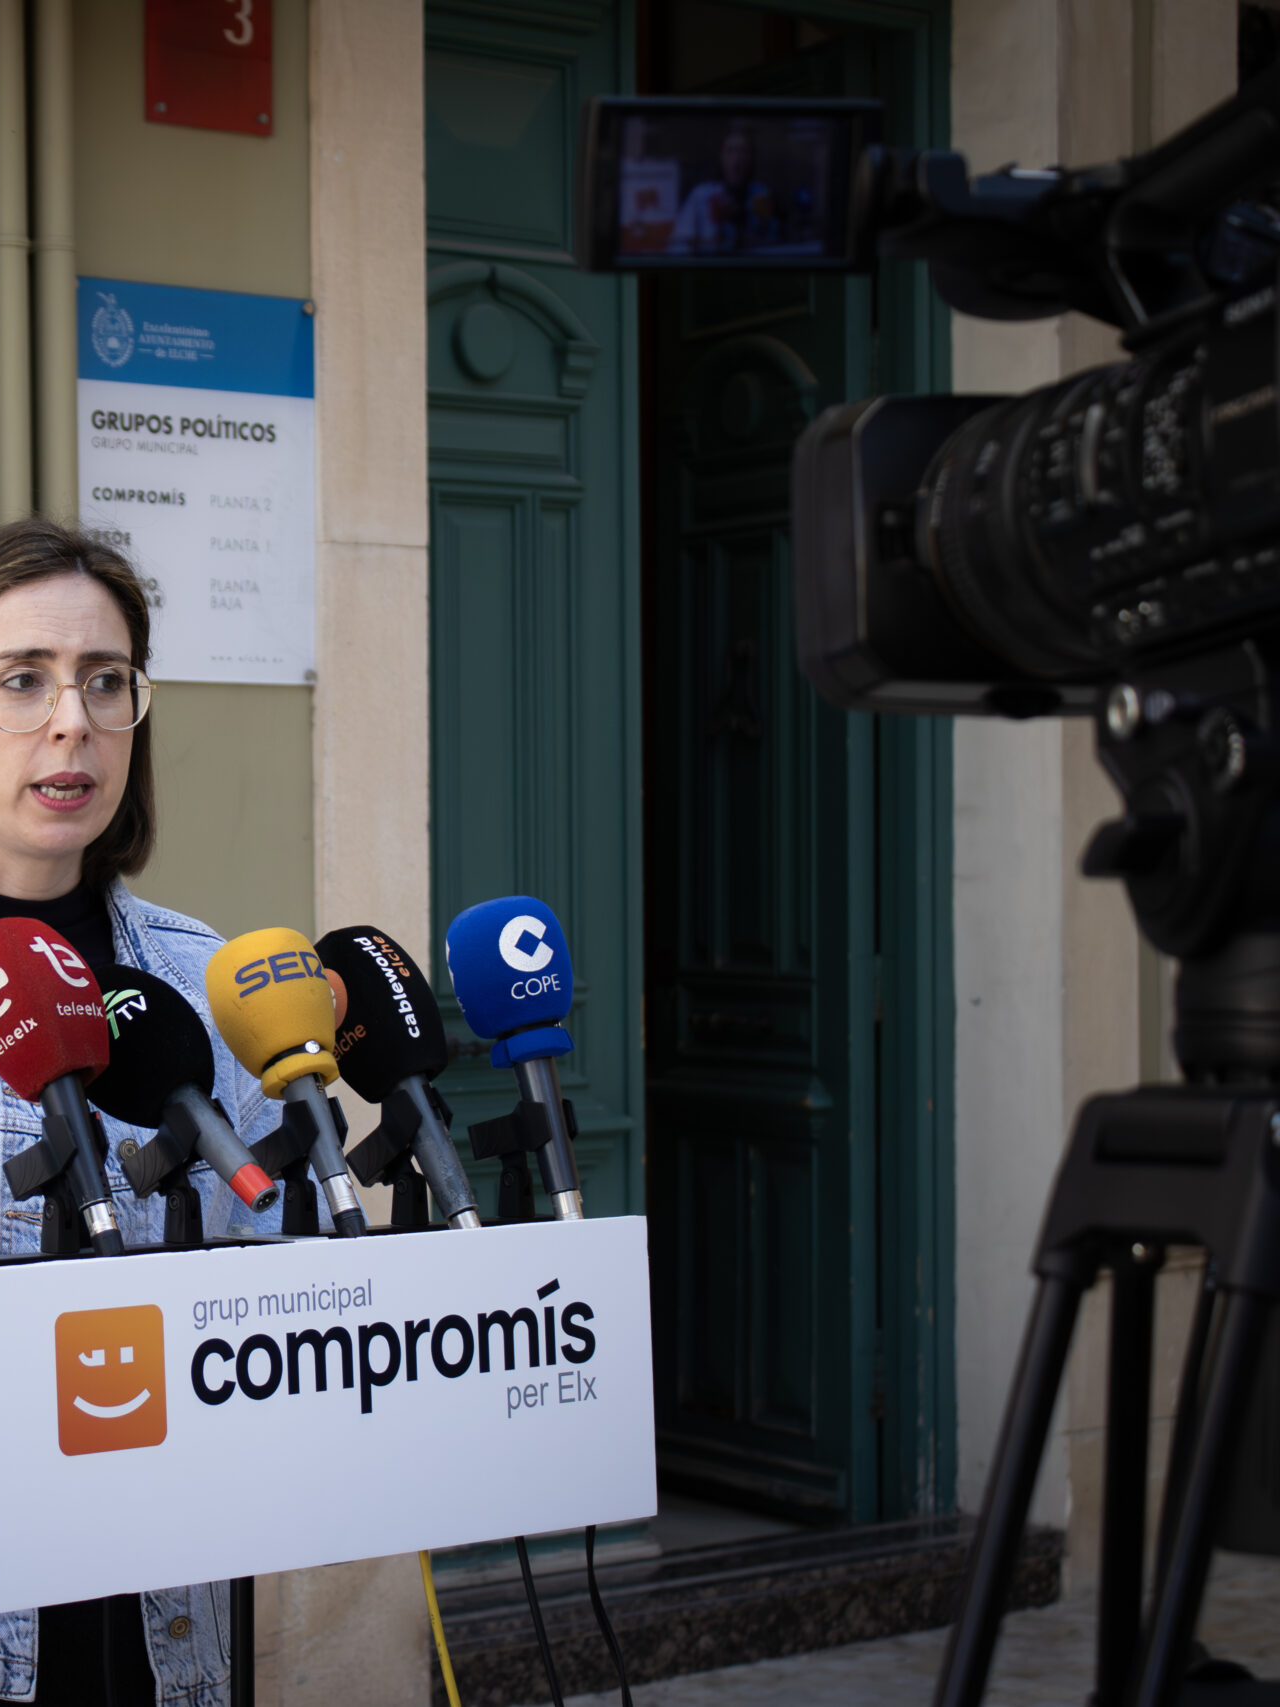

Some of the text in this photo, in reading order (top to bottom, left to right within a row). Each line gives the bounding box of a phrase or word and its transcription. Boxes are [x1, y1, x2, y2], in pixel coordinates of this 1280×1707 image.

[223, 0, 254, 46] 3
[91, 409, 276, 443] GRUPOS POLÍTICOS
[91, 436, 199, 456] GRUPO MUNICIPAL
[92, 485, 272, 512] COMPROMÍS PLANTA 2
[209, 536, 260, 553] PLANTA
[209, 578, 260, 594] PLANTA
[209, 596, 242, 611] BAJA
[372, 935, 411, 978] elche
[353, 936, 421, 1039] cableworld
[510, 973, 561, 1000] COPE
[56, 1001, 104, 1018] teleelx
[191, 1278, 373, 1330] grup municipal
[190, 1277, 597, 1415] compromís
[506, 1370, 598, 1419] per Elx
